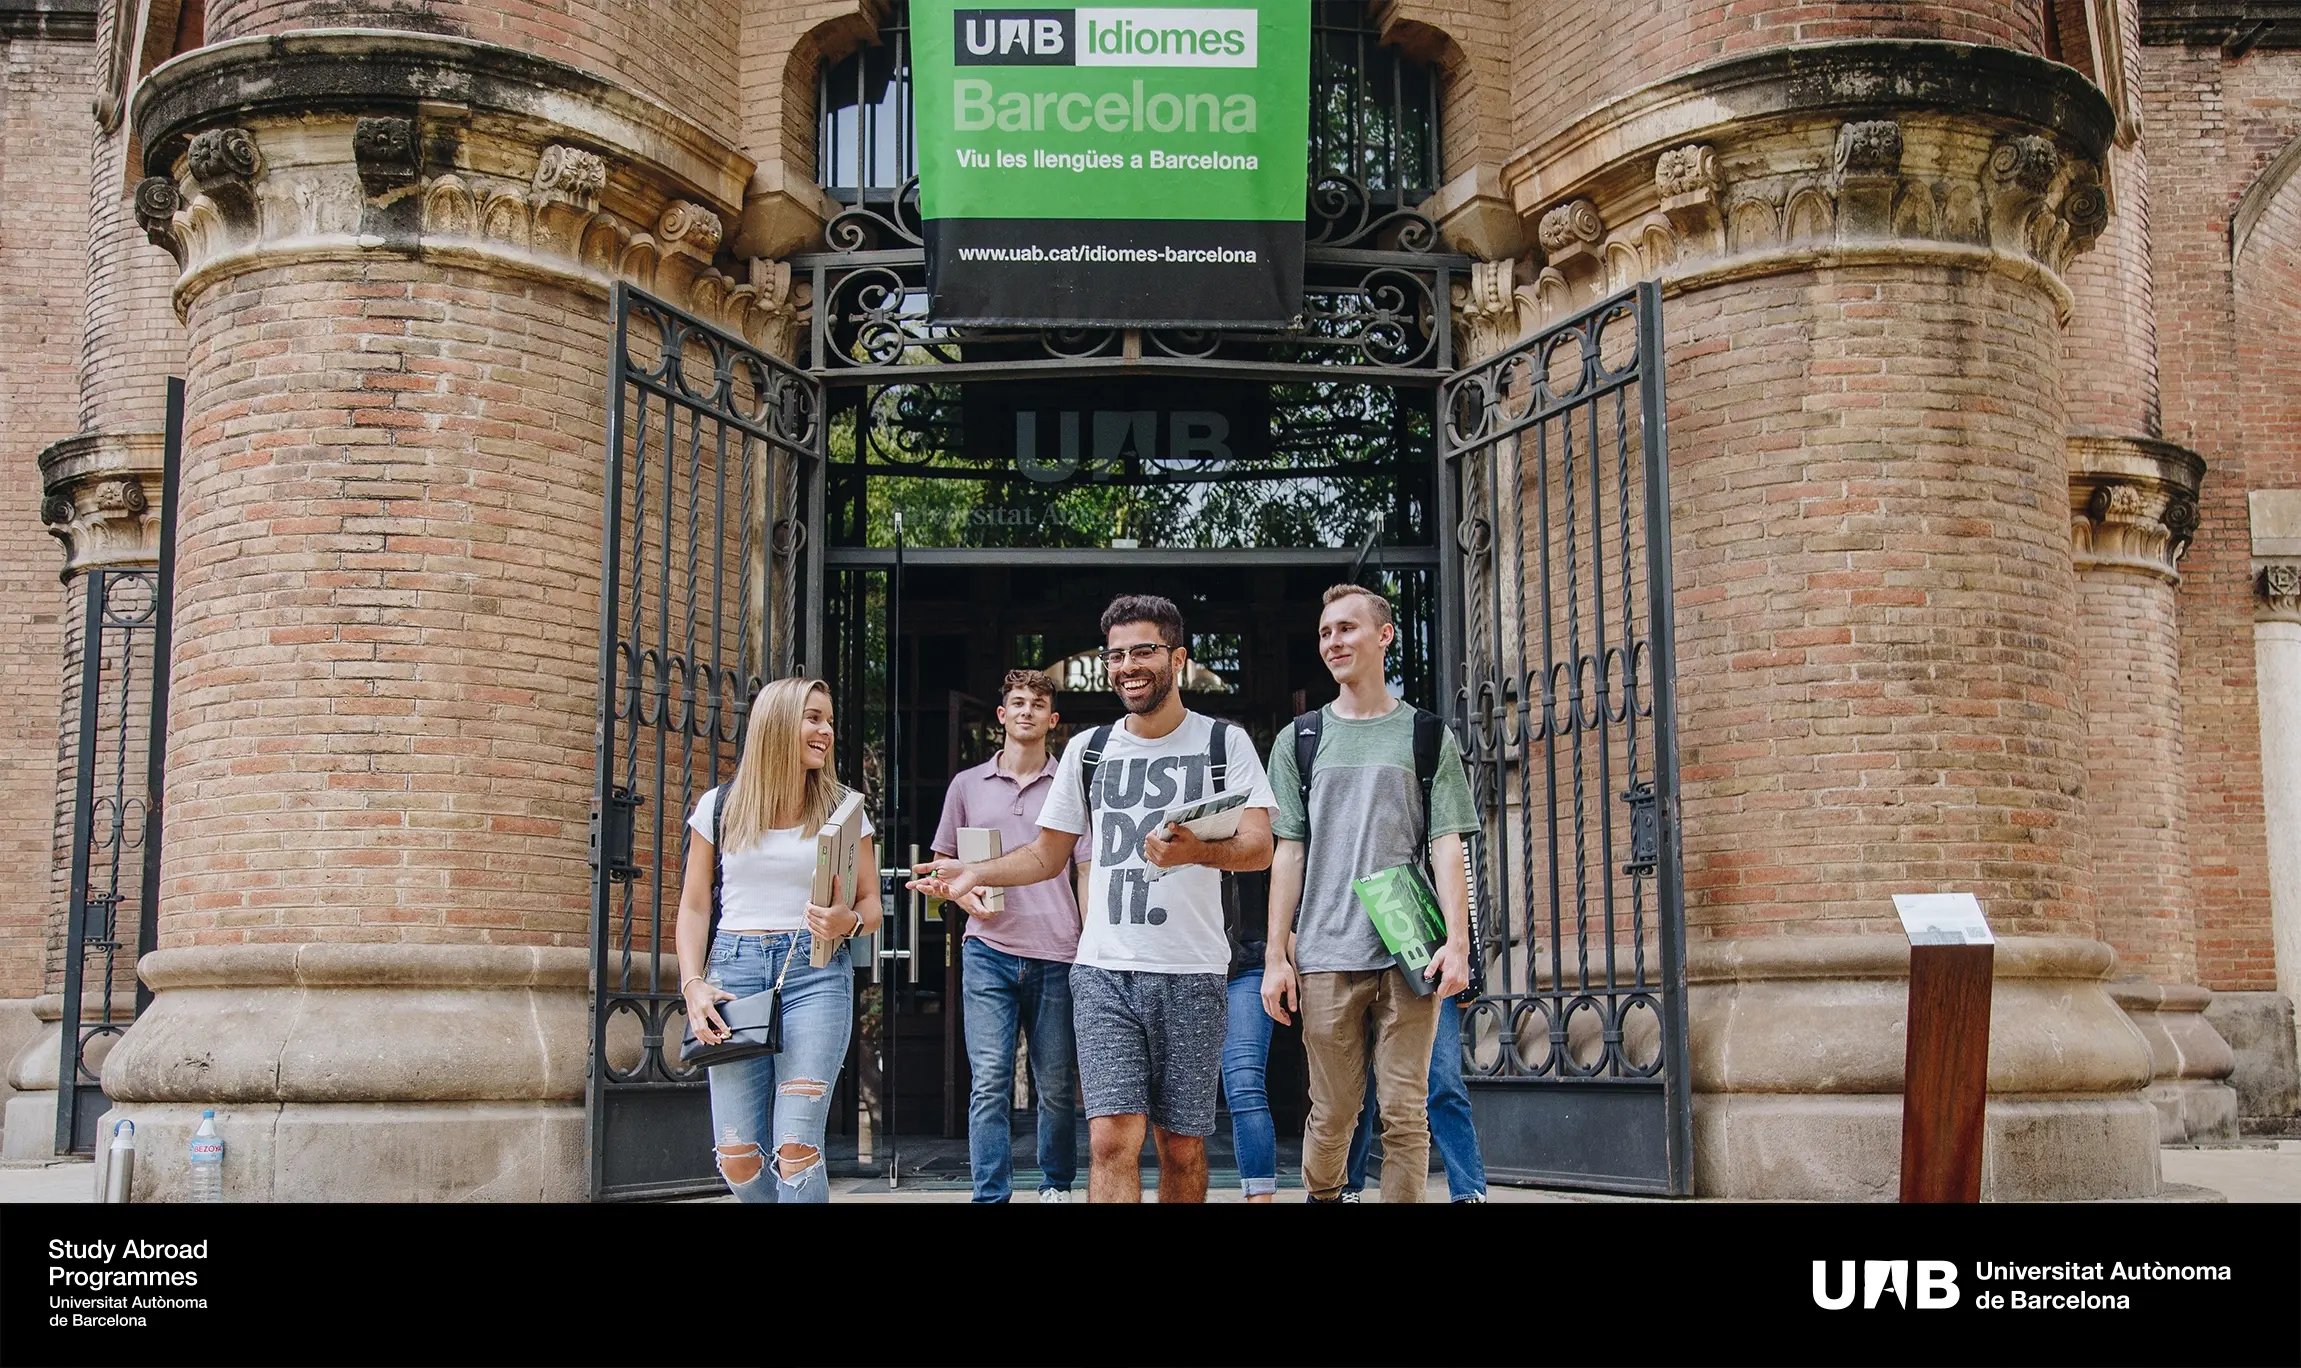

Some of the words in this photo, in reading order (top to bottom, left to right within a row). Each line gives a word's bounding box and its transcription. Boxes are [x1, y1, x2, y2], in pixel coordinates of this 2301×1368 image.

[965, 19, 1064, 56] UAB
[1088, 19, 1246, 56] Idiomes
[953, 78, 1257, 134] Barcelona
[956, 149, 990, 168] Viu
[996, 149, 1027, 168] les
[1033, 149, 1124, 172] llengües
[1130, 154, 1143, 169] a
[1150, 150, 1258, 170] Barcelona
[958, 245, 1257, 264] www.uab.cat/idiomes-barcelona
[1016, 410, 1233, 482] UAB
[1364, 878, 1432, 971] BCN
